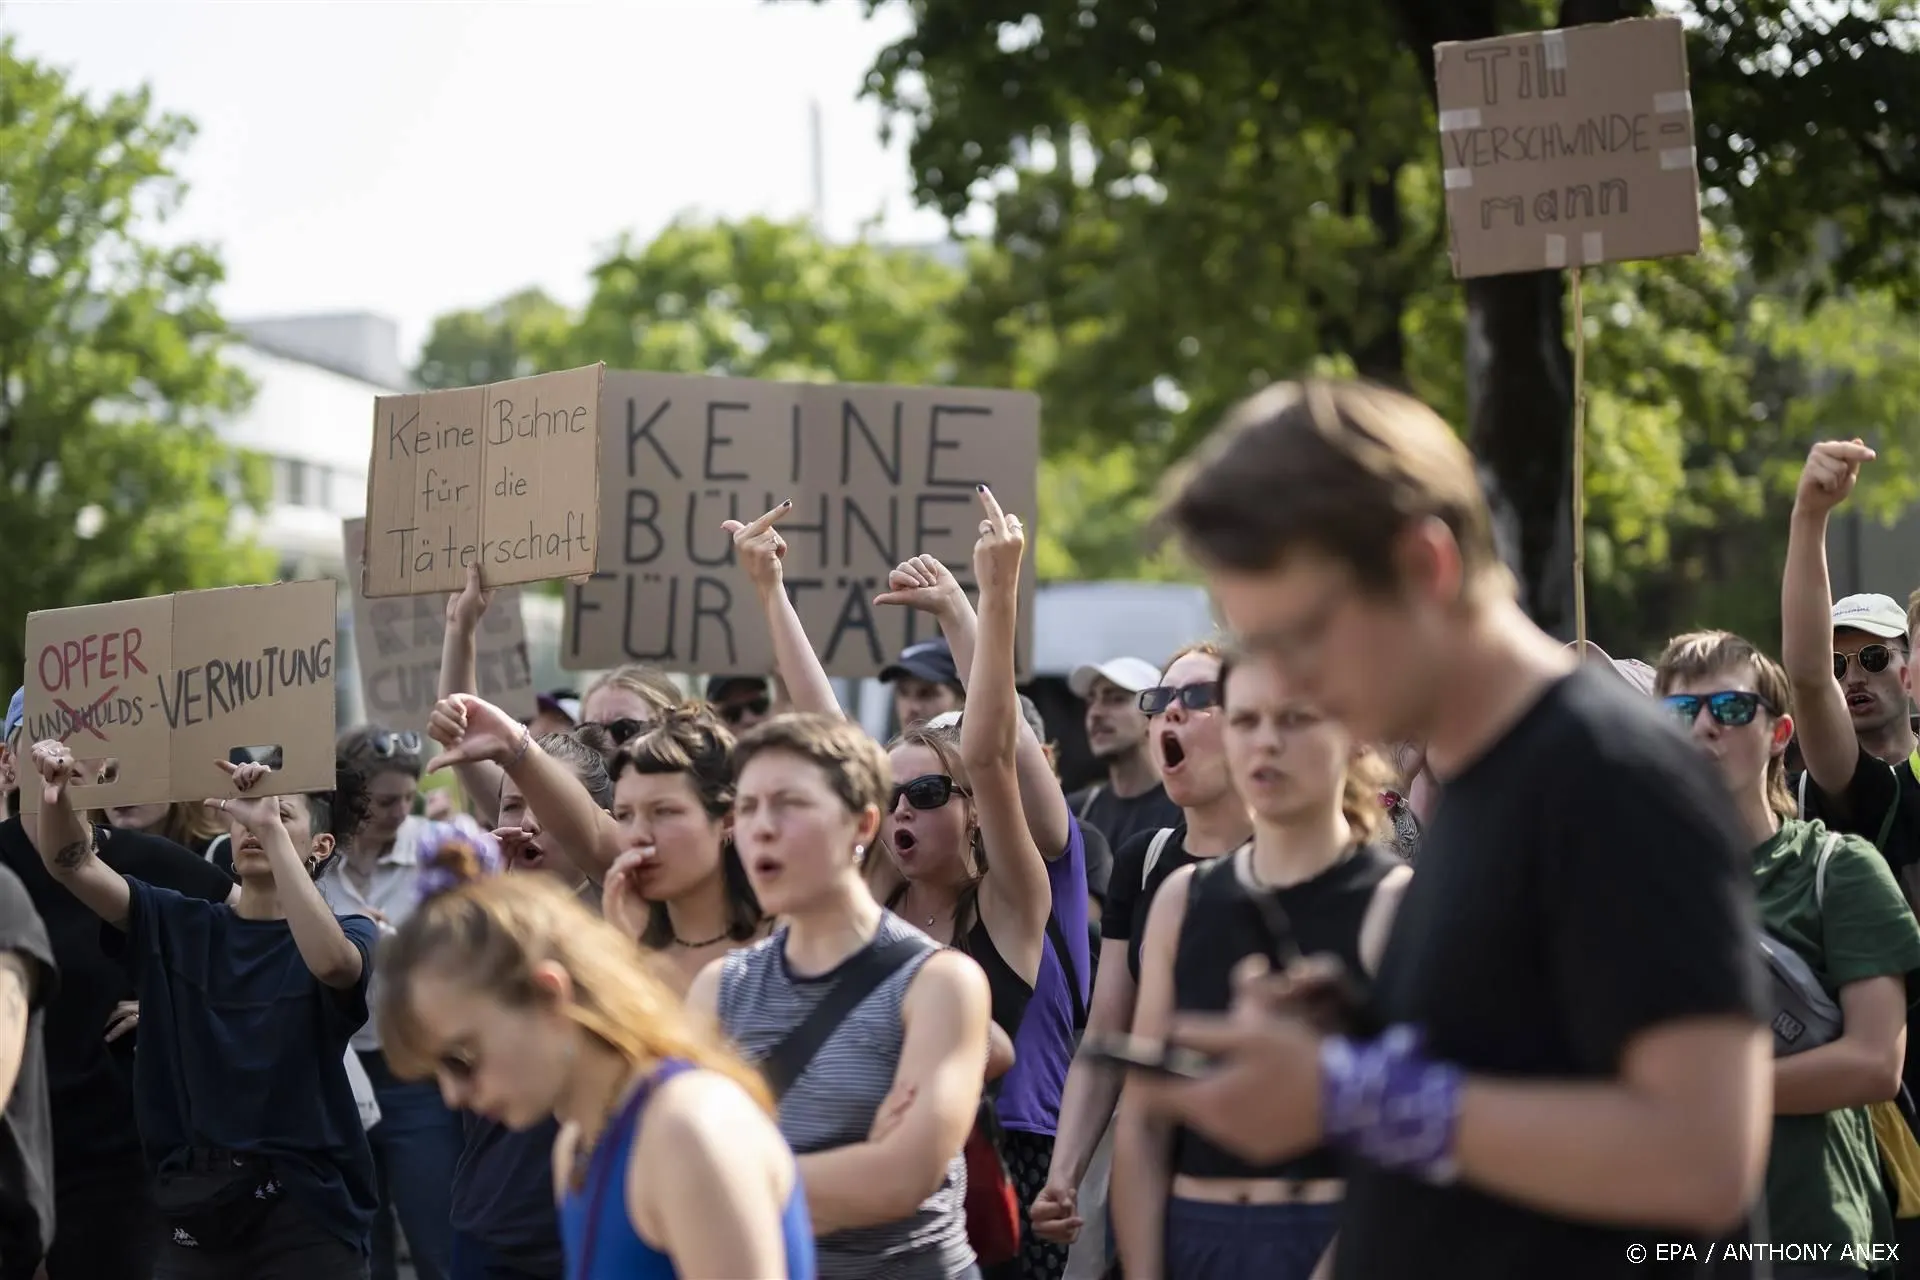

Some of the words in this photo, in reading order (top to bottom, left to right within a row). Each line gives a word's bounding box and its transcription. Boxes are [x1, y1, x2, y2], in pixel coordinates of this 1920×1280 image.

[1465, 44, 1567, 105] Till
[1480, 178, 1629, 230] mann
[389, 411, 475, 460] Keine
[625, 399, 993, 489] KEINE
[422, 468, 470, 512] für
[494, 466, 528, 497] die
[386, 510, 591, 578] Täterschaft
[624, 489, 977, 569] BÜHNE
[571, 572, 738, 666] FÜR
[38, 627, 149, 692] OPFER
